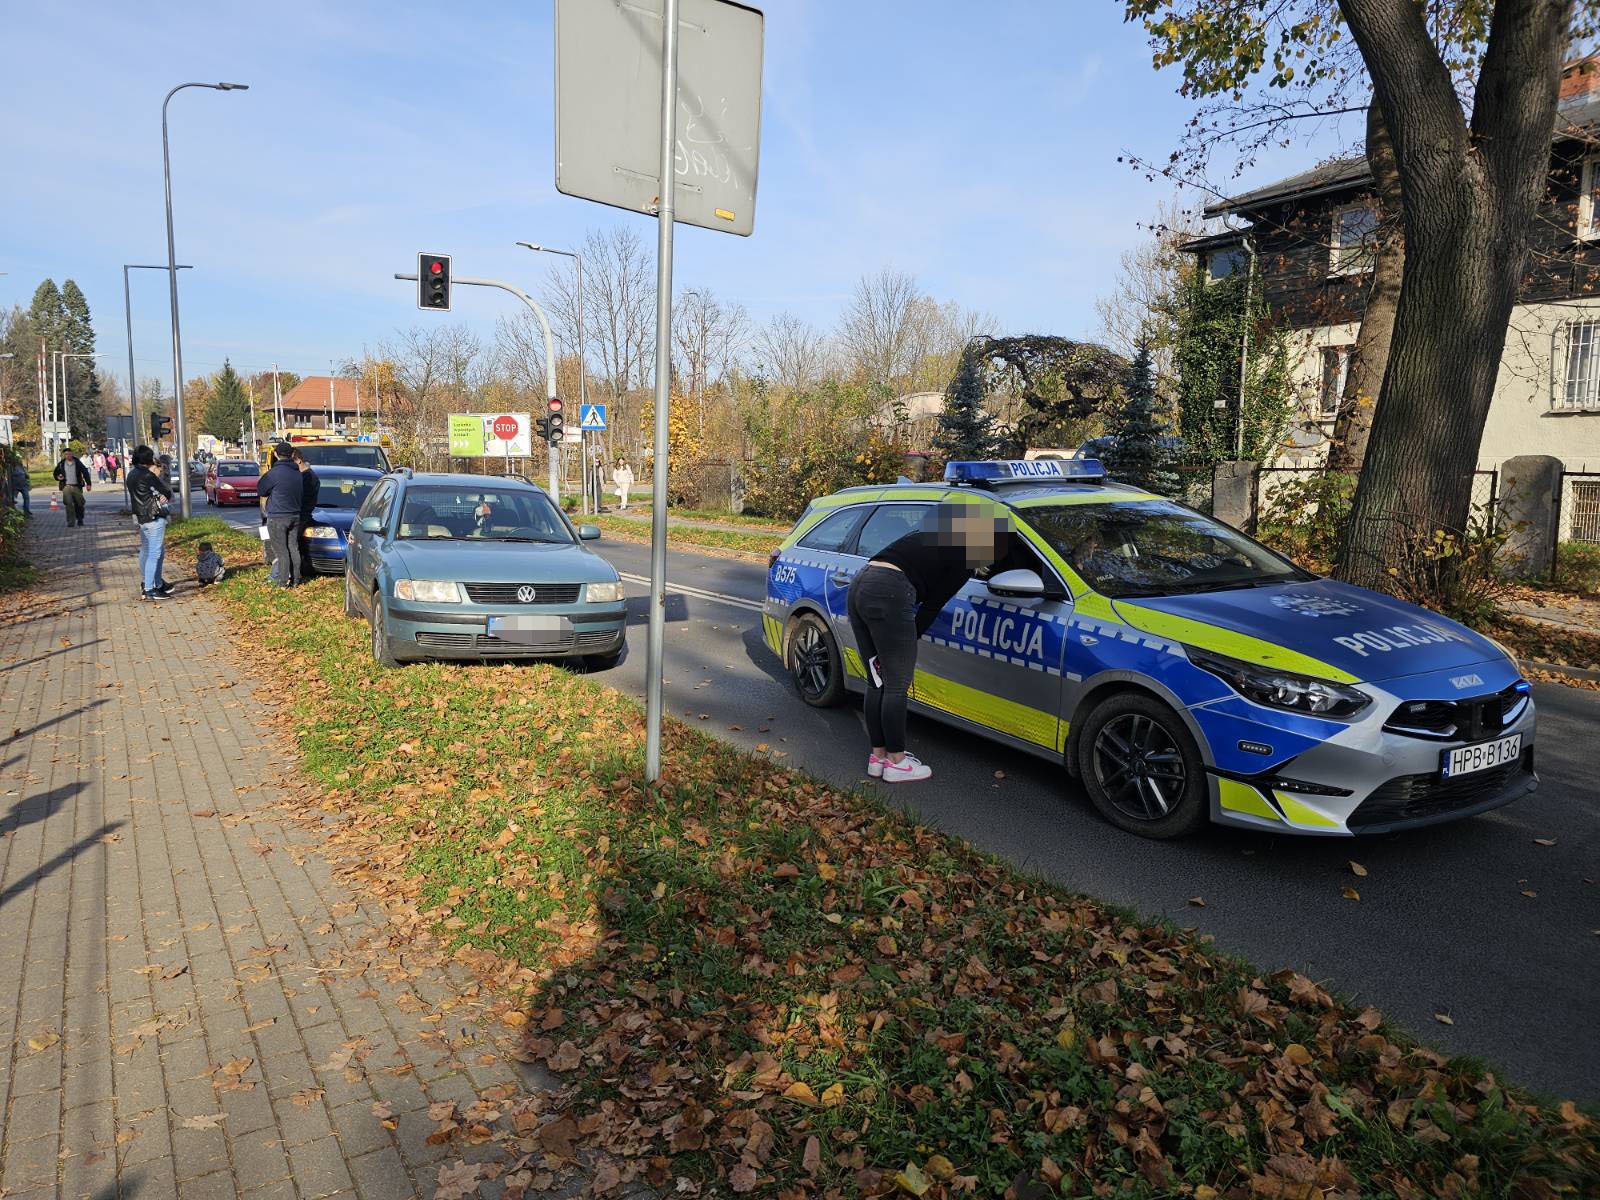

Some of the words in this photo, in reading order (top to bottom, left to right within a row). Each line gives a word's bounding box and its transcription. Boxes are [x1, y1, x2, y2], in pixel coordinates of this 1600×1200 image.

[495, 423, 517, 432] STOP
[1010, 461, 1061, 477] POLICJA
[775, 565, 797, 584] B575
[951, 607, 1044, 659] POLICJA
[1332, 624, 1464, 657] POLICJA
[1448, 673, 1485, 690] KIA
